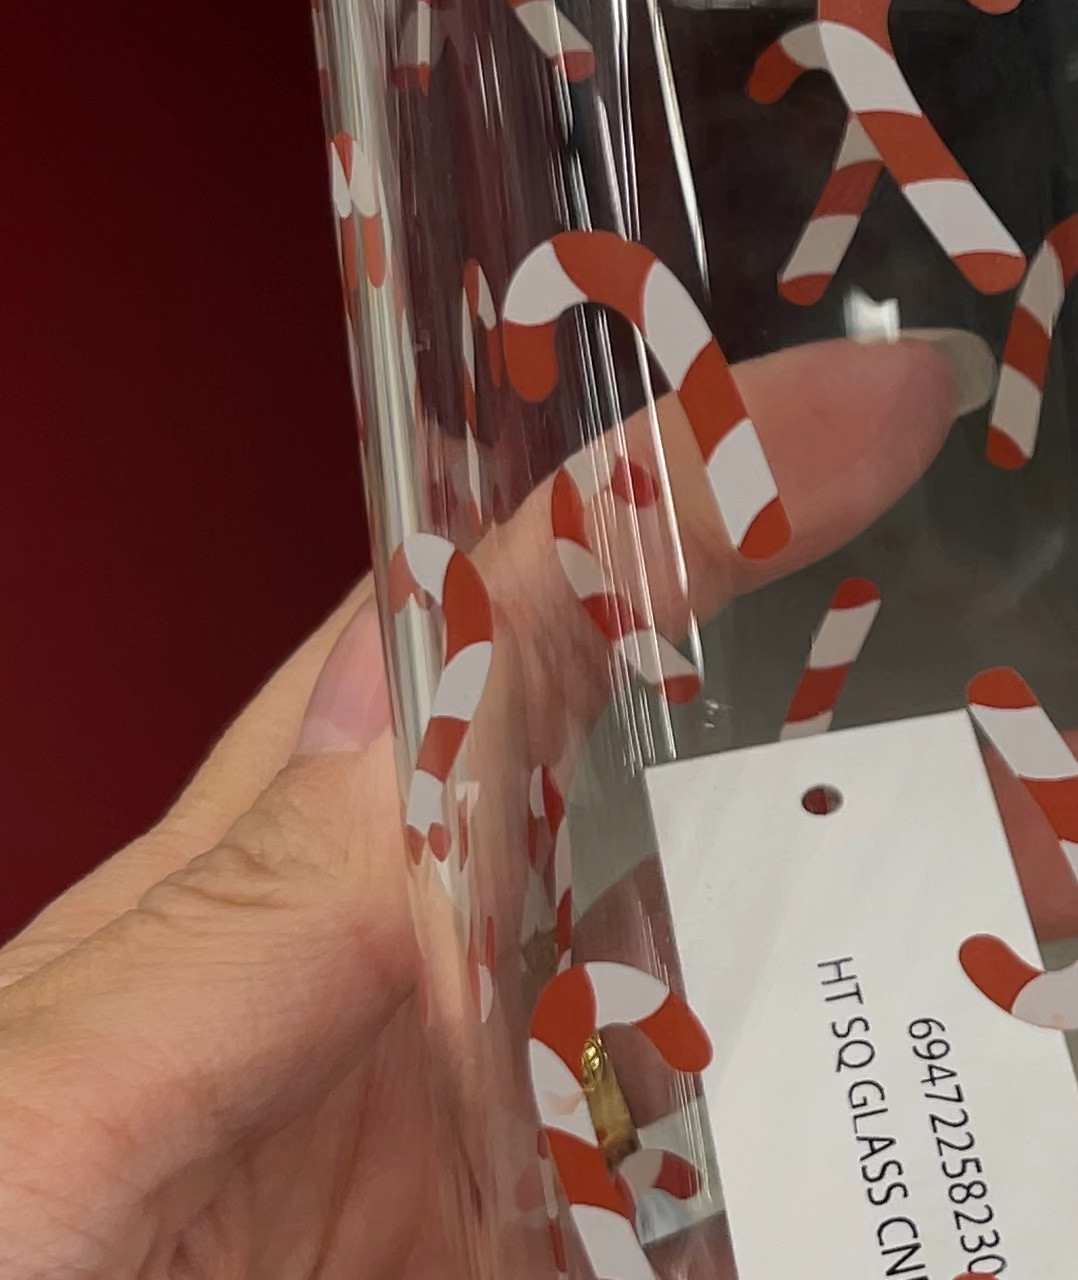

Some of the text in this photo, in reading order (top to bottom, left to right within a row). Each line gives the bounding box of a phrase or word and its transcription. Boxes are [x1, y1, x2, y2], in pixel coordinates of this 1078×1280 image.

[817, 956, 864, 1005] HT
[831, 1016, 875, 1073] SQ
[848, 1079, 908, 1206] GLASS
